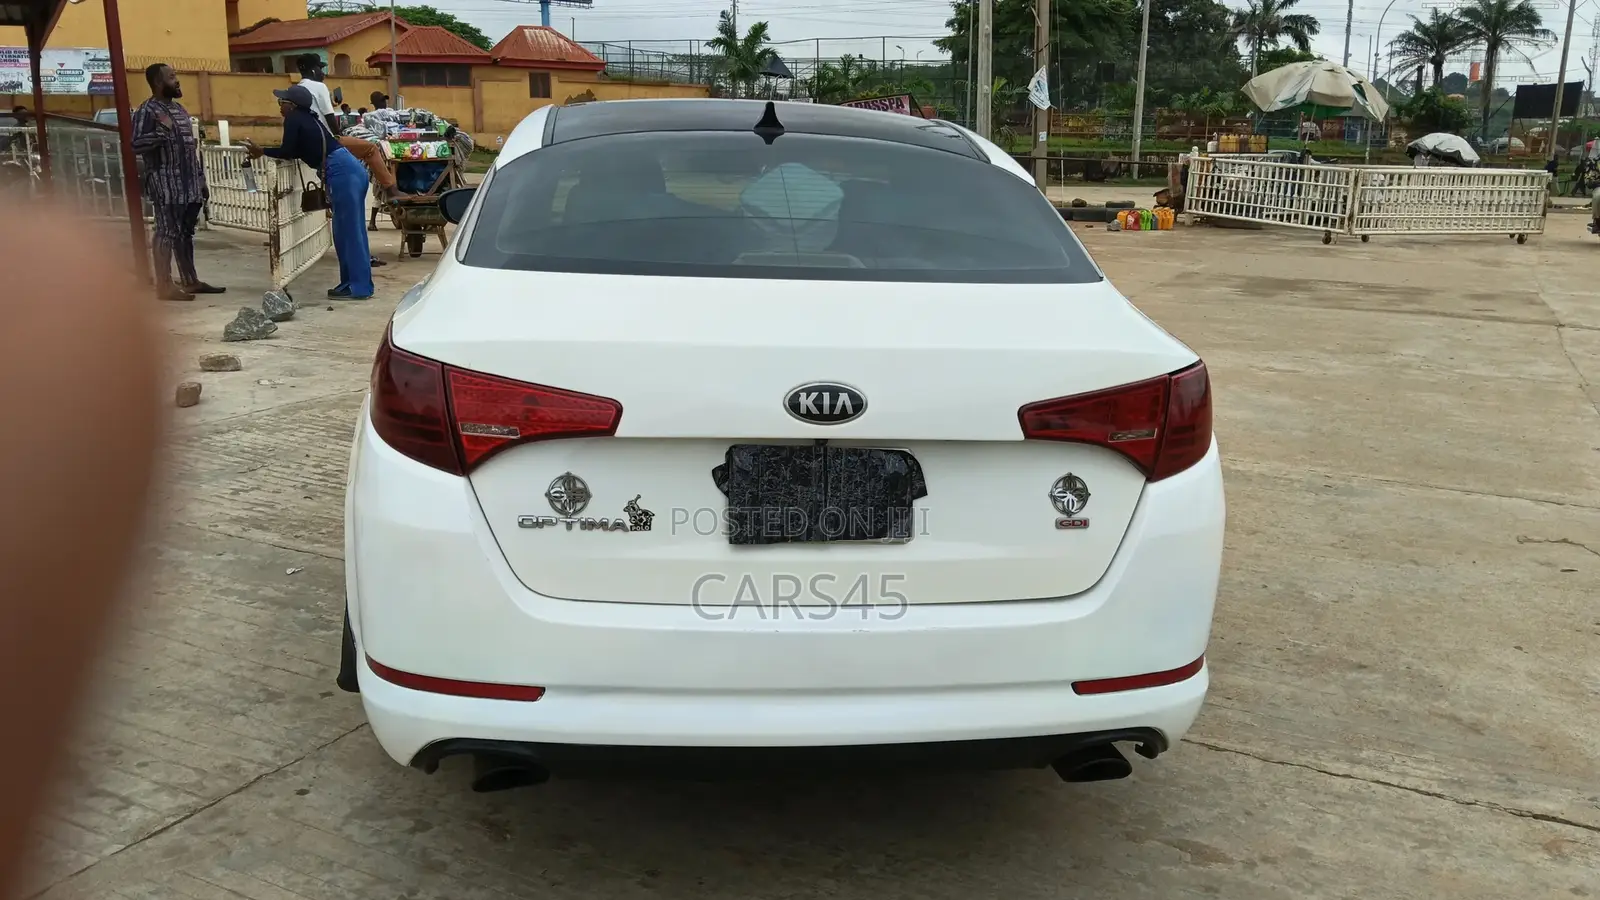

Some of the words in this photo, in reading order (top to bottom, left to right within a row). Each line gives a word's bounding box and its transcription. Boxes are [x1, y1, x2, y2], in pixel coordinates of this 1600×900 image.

[799, 392, 854, 414] KIA
[518, 515, 629, 532] OPTIMA
[1058, 518, 1088, 528] GDI
